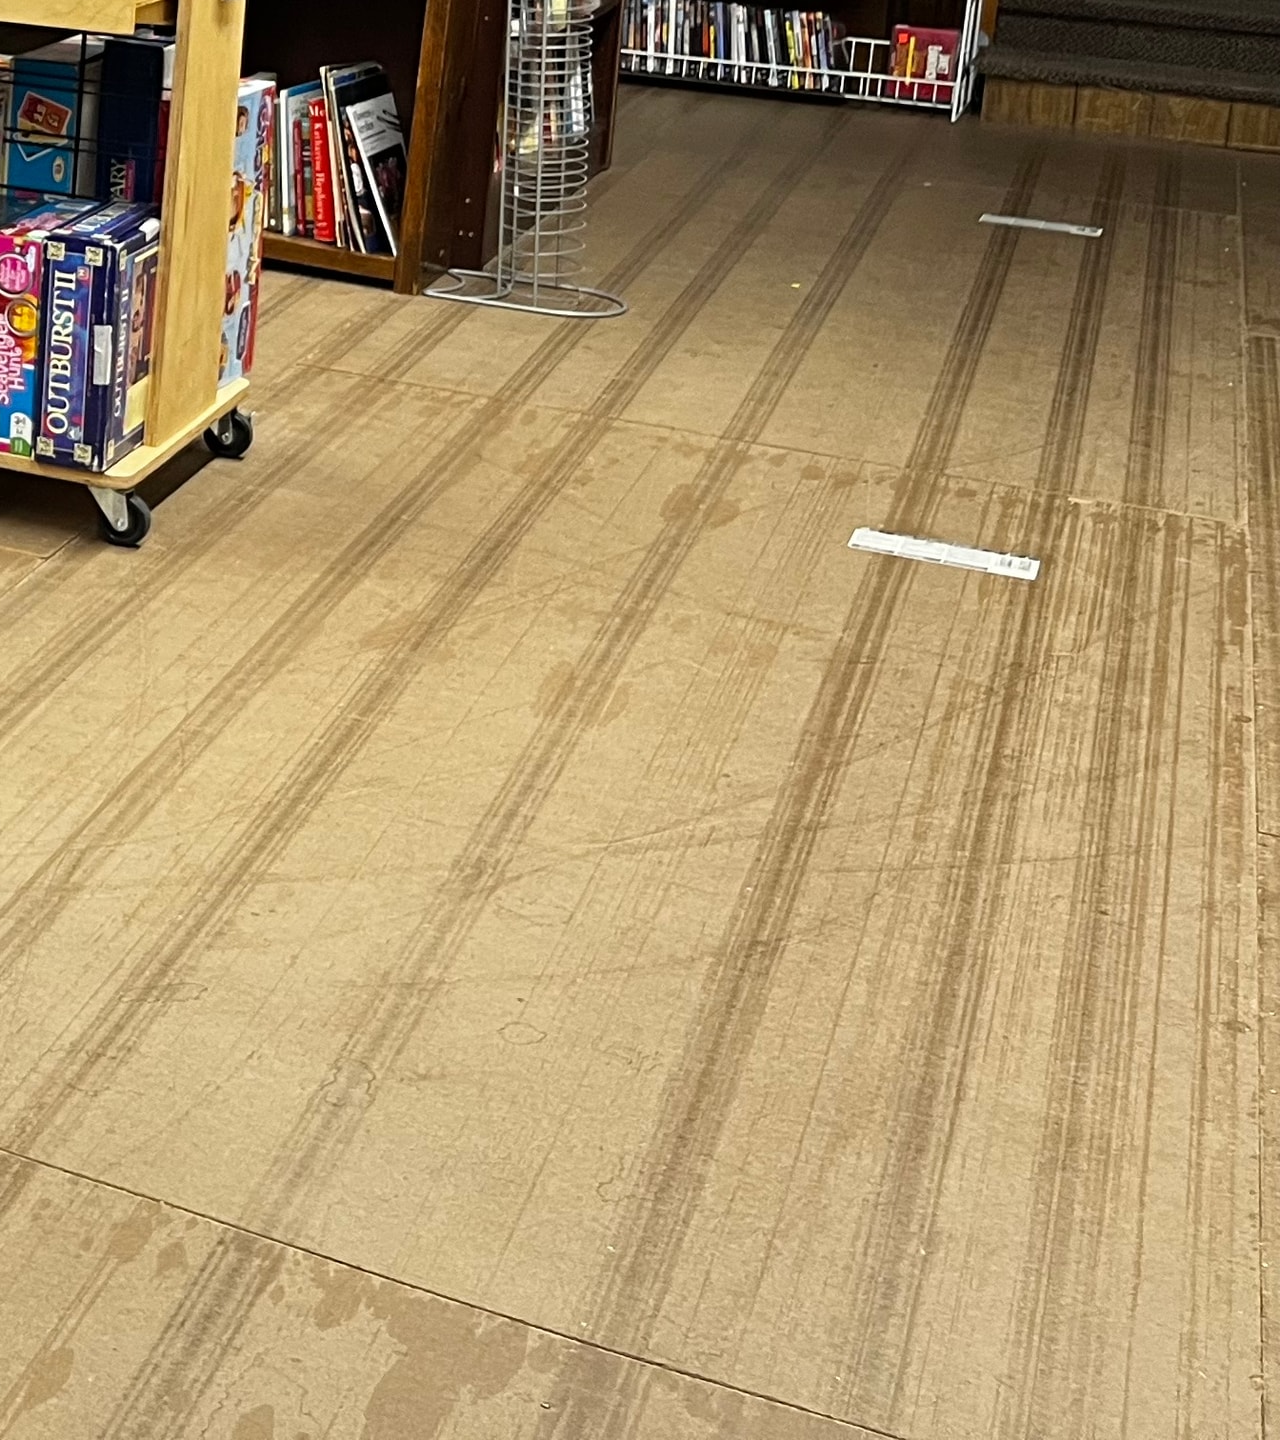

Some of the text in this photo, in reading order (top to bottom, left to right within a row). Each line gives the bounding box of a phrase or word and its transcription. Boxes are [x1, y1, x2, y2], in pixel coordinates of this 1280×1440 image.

[313, 122, 325, 171] Katharine
[8, 347, 25, 392] Hunt
[46, 268, 77, 435] OUTBURST II
